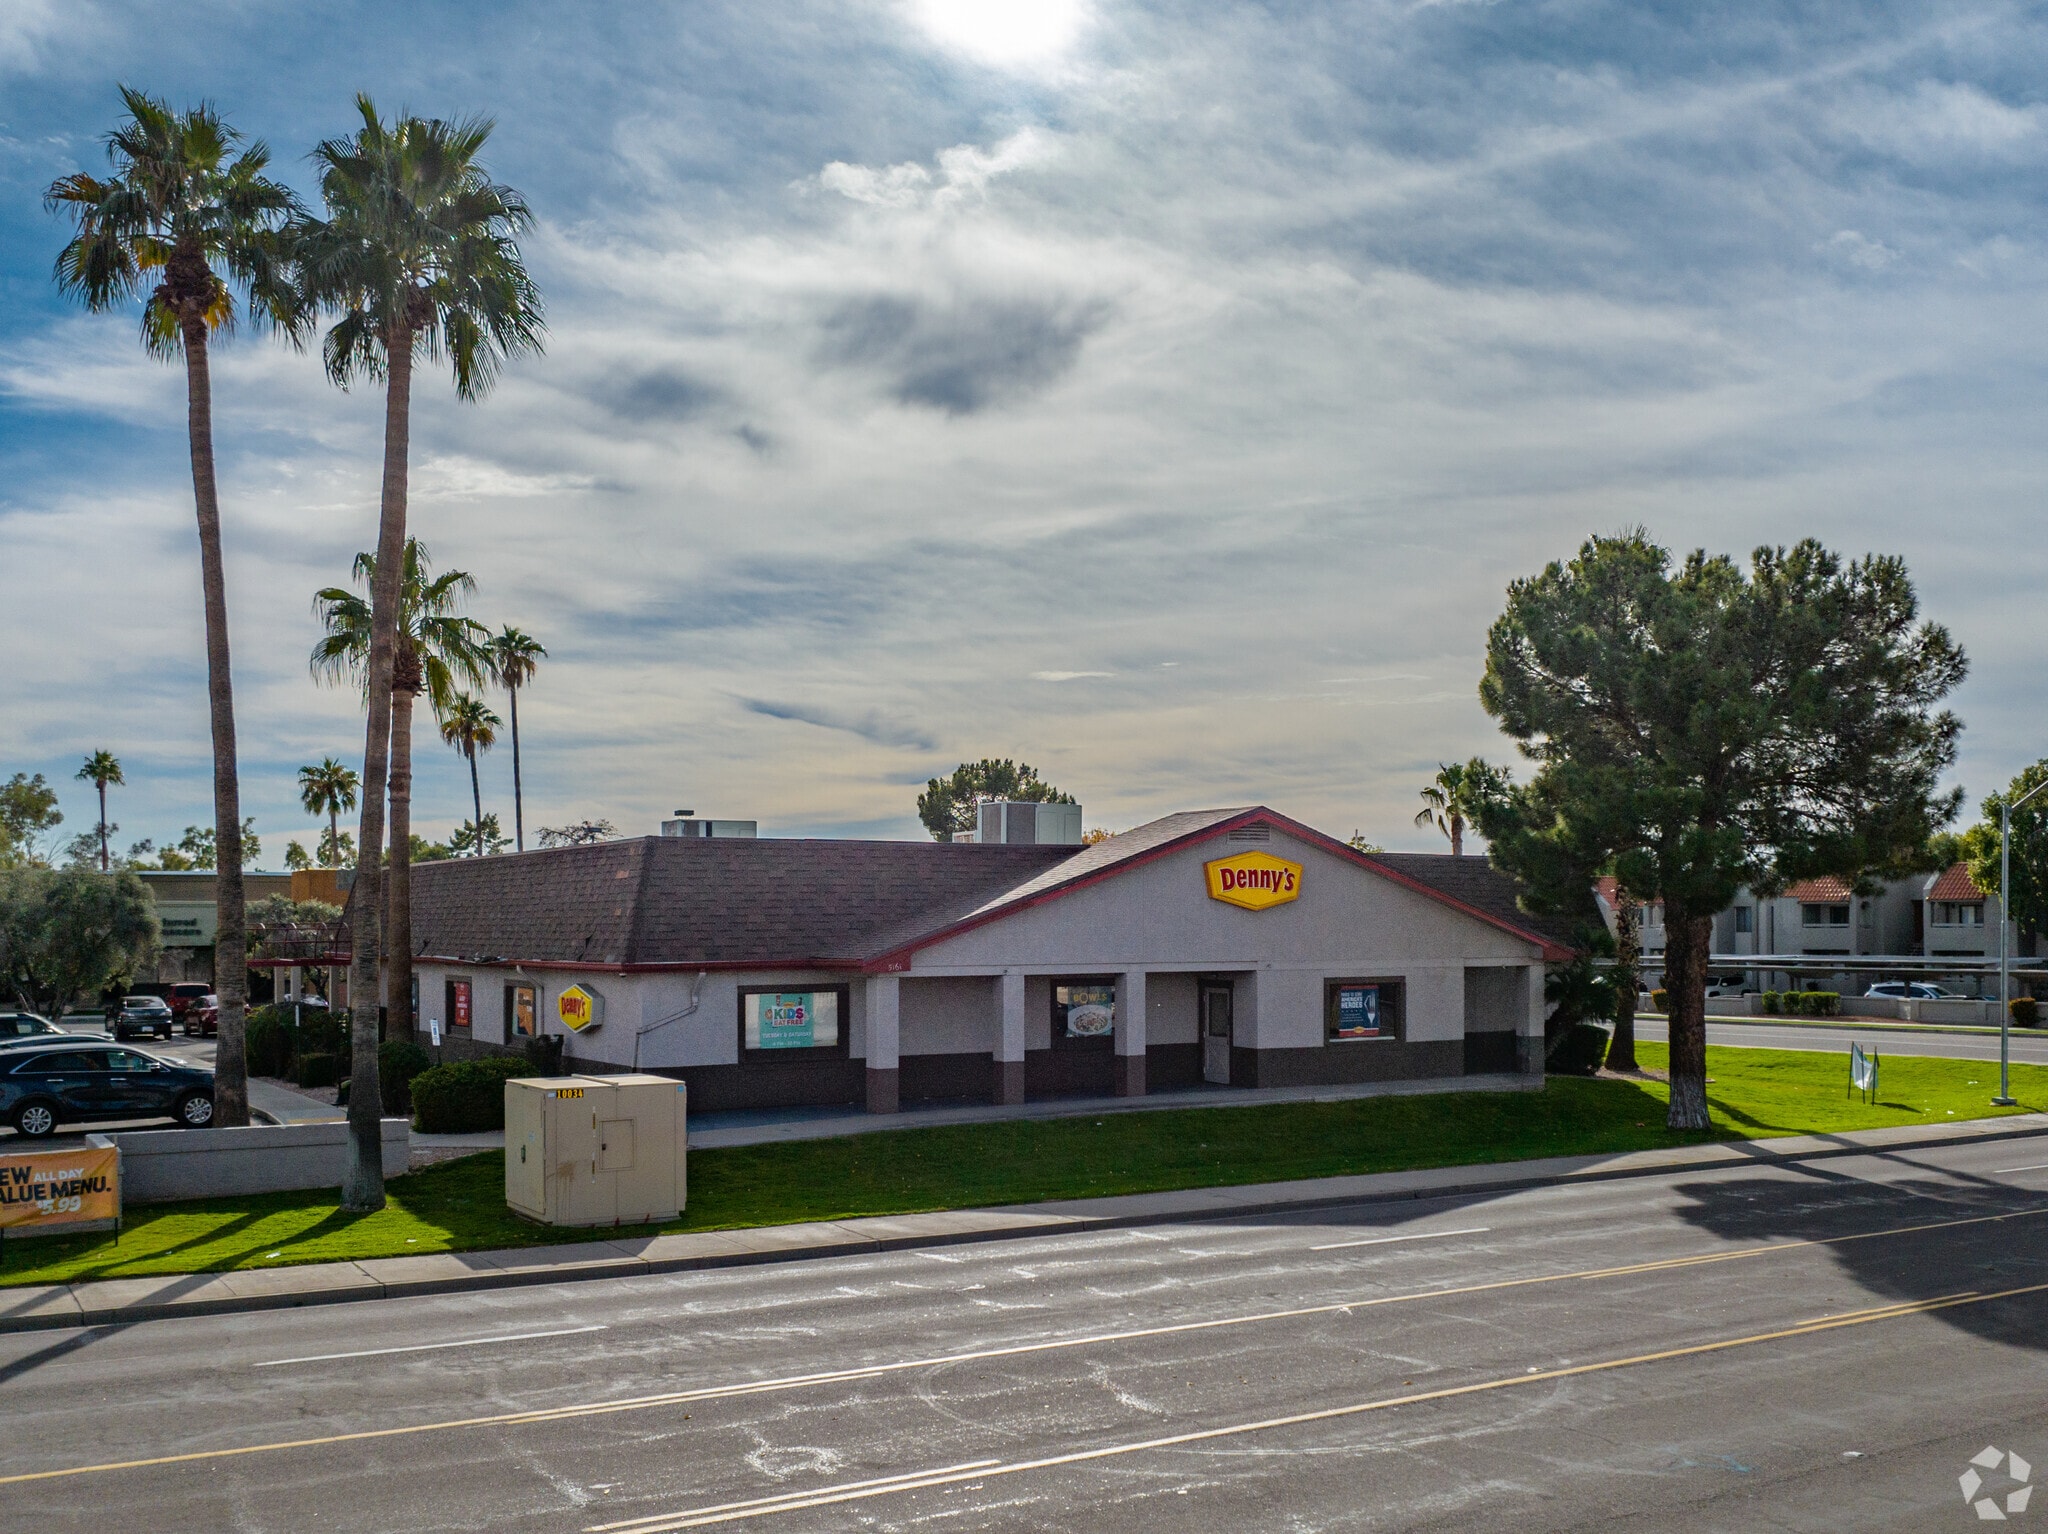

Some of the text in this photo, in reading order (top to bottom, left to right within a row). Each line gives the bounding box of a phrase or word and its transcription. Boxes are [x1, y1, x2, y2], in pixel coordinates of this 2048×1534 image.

[1219, 867, 1296, 893] Denny's
[561, 996, 586, 1018] Denny's
[774, 1007, 804, 1020] KIDS
[557, 1089, 583, 1099] 10034
[34, 1171, 57, 1182] ALL
[58, 1168, 84, 1180] DAY
[50, 1176, 112, 1199] MENU.
[37, 1195, 82, 1216] $5.99
